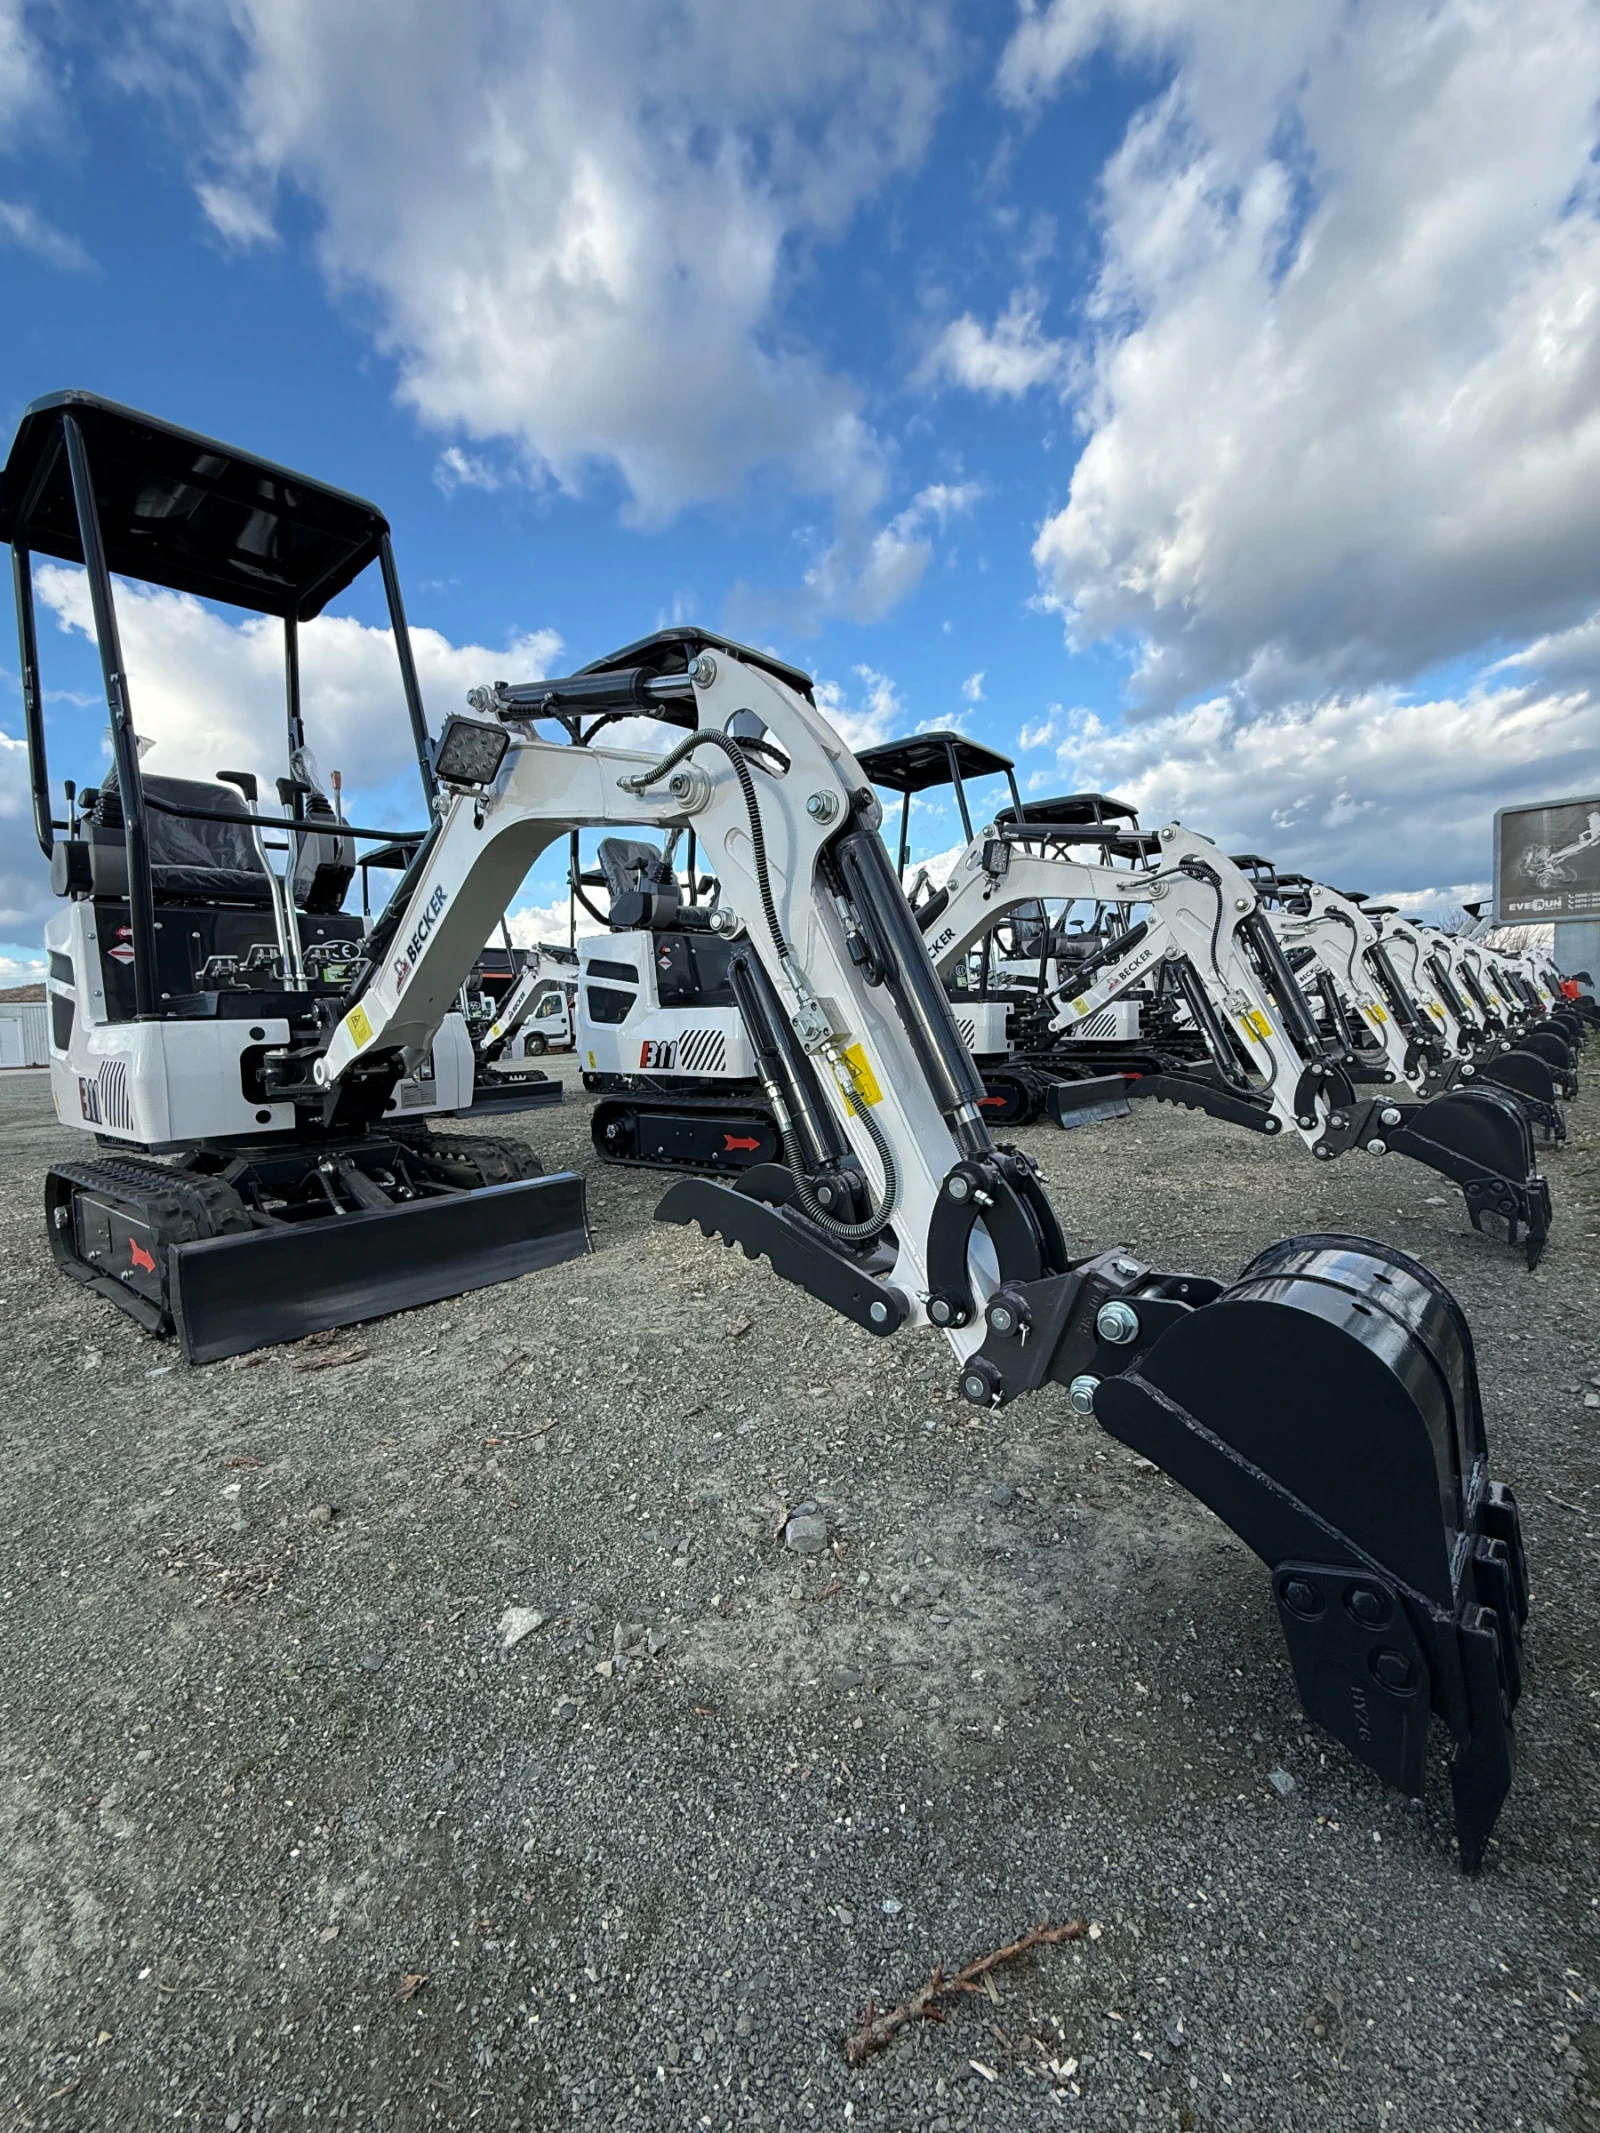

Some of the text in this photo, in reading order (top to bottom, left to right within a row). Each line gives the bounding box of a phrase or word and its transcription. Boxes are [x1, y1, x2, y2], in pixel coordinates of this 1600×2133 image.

[1508, 896, 1562, 911] EVERUN
[406, 884, 448, 966] BECKER
[1118, 949, 1153, 980] BECKER
